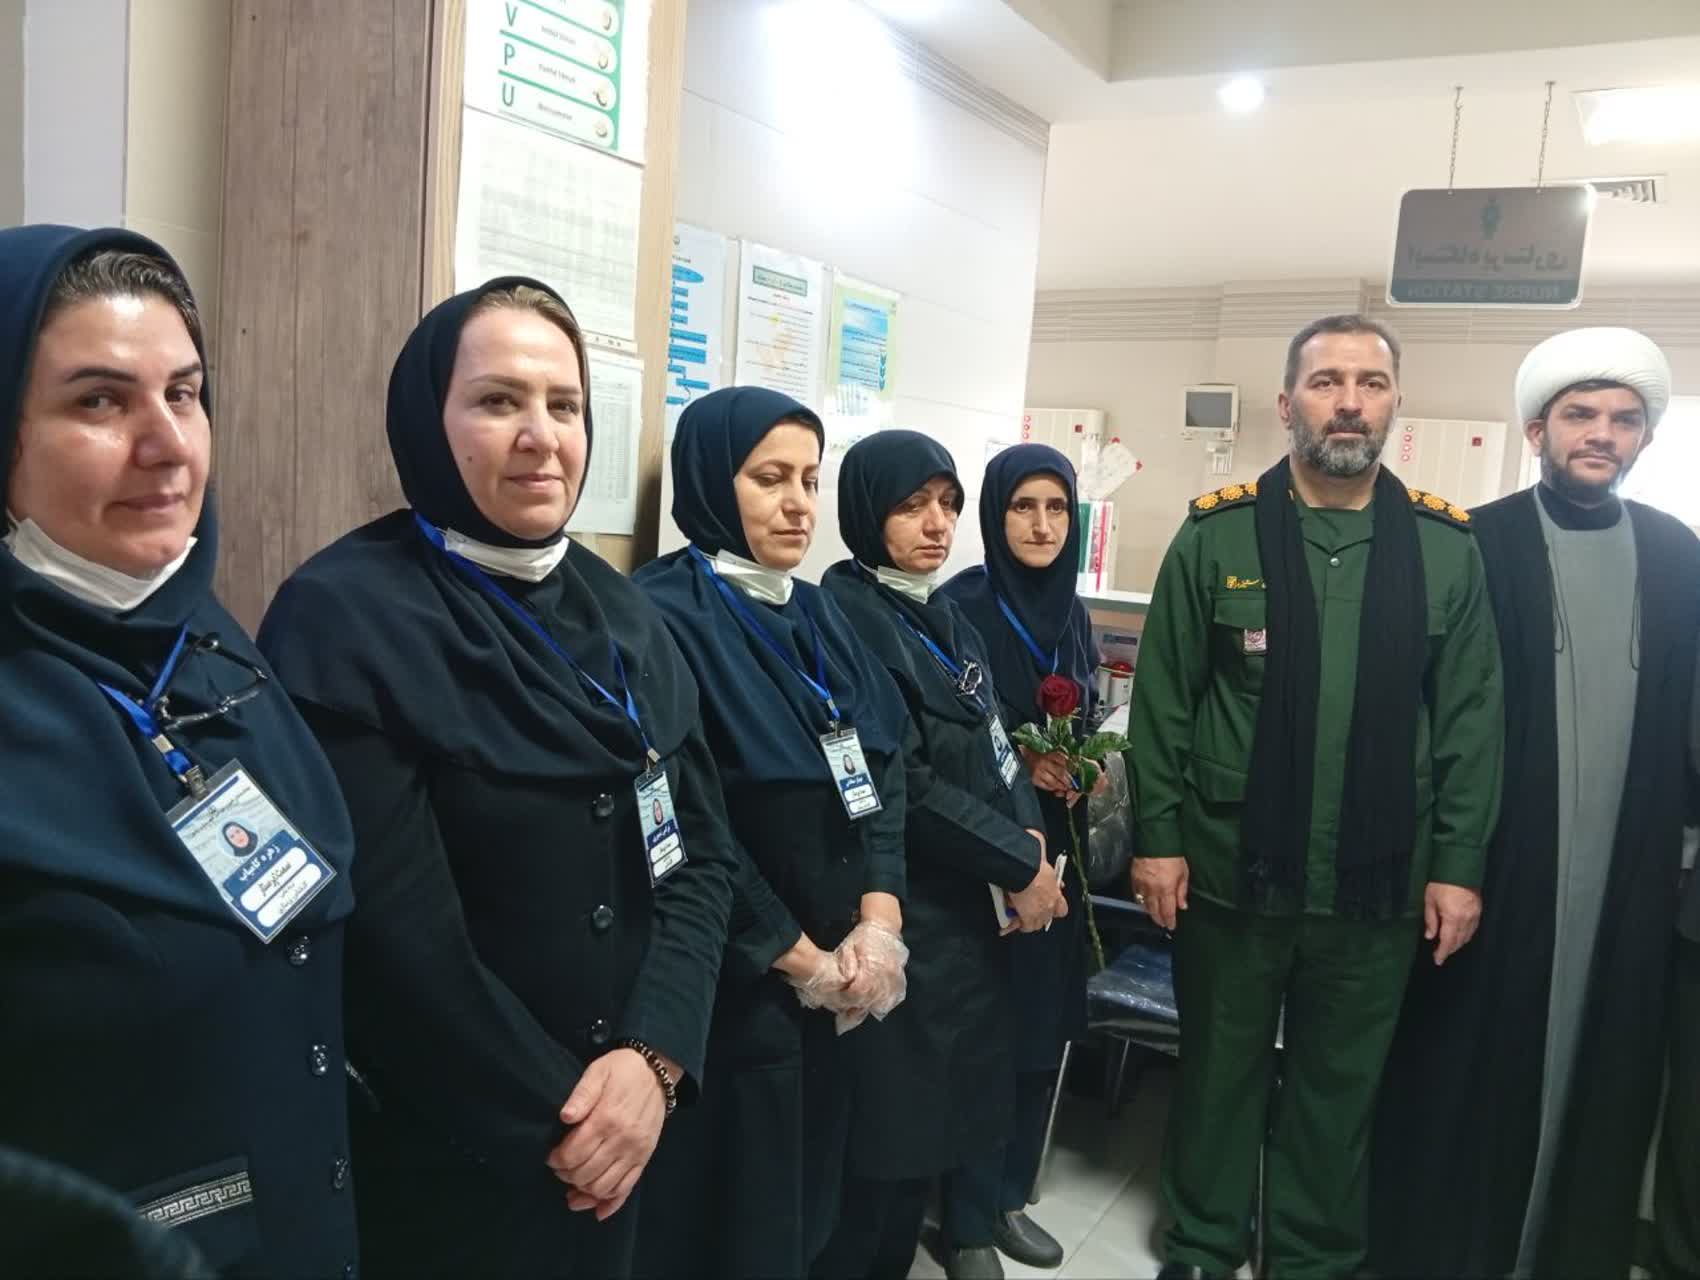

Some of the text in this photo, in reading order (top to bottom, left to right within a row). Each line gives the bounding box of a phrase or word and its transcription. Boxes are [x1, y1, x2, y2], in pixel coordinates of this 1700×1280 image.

[505, 2, 518, 27] V
[503, 42, 516, 66] P
[502, 83, 515, 107] U
